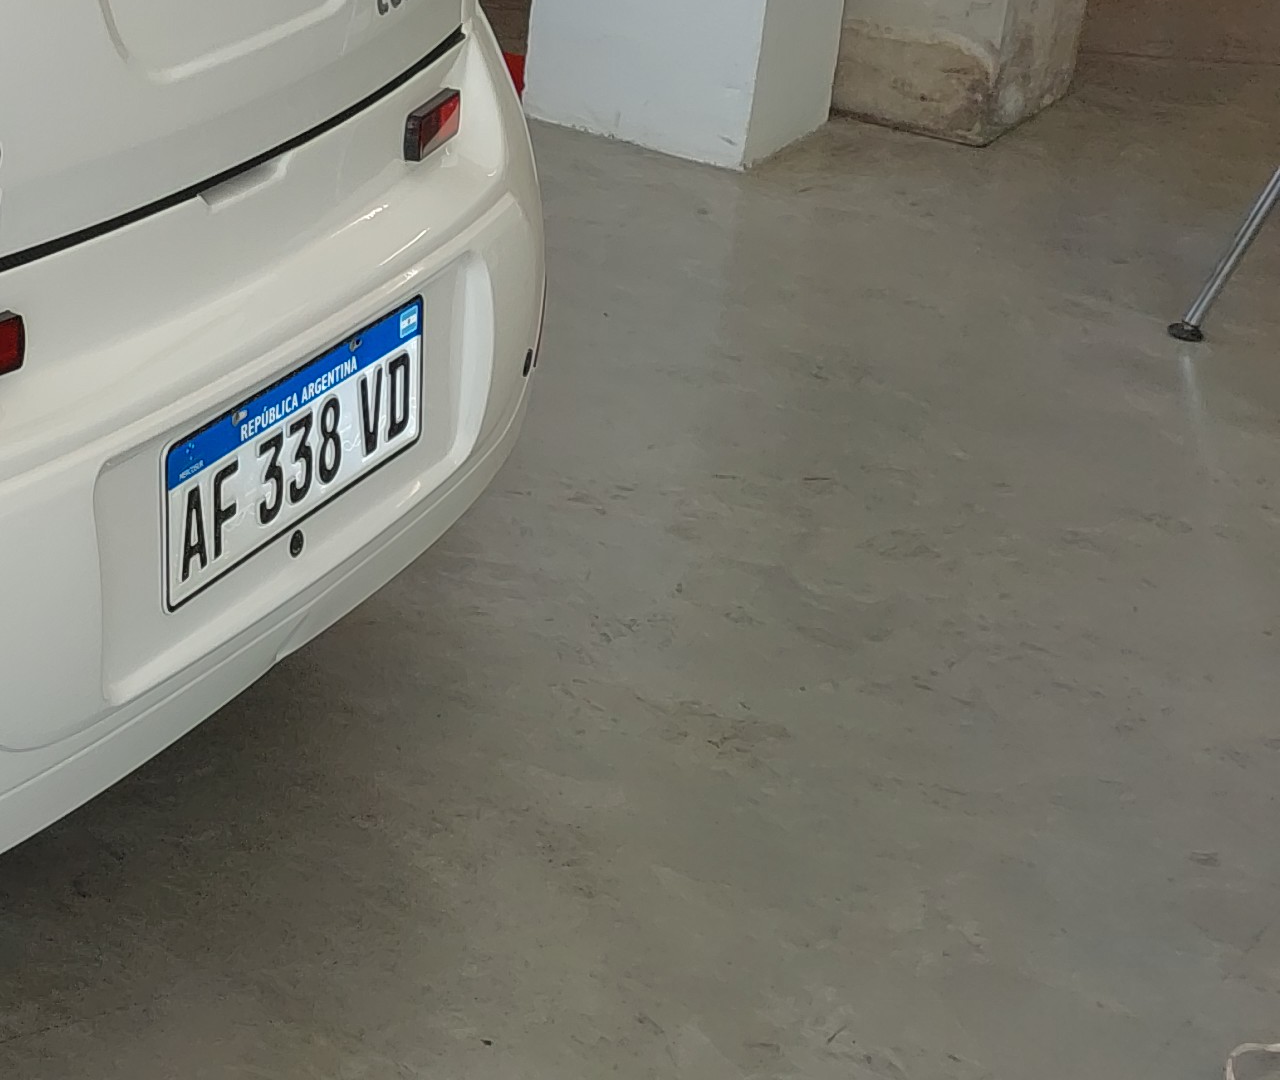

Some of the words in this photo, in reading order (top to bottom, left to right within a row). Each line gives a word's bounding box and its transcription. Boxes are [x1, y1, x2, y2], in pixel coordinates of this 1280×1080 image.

[181, 458, 239, 584] AF
[257, 396, 340, 526] 338
[360, 351, 410, 458] VD
[240, 392, 298, 442] REPÚBLICA
[301, 355, 357, 404] ARGENTINA
